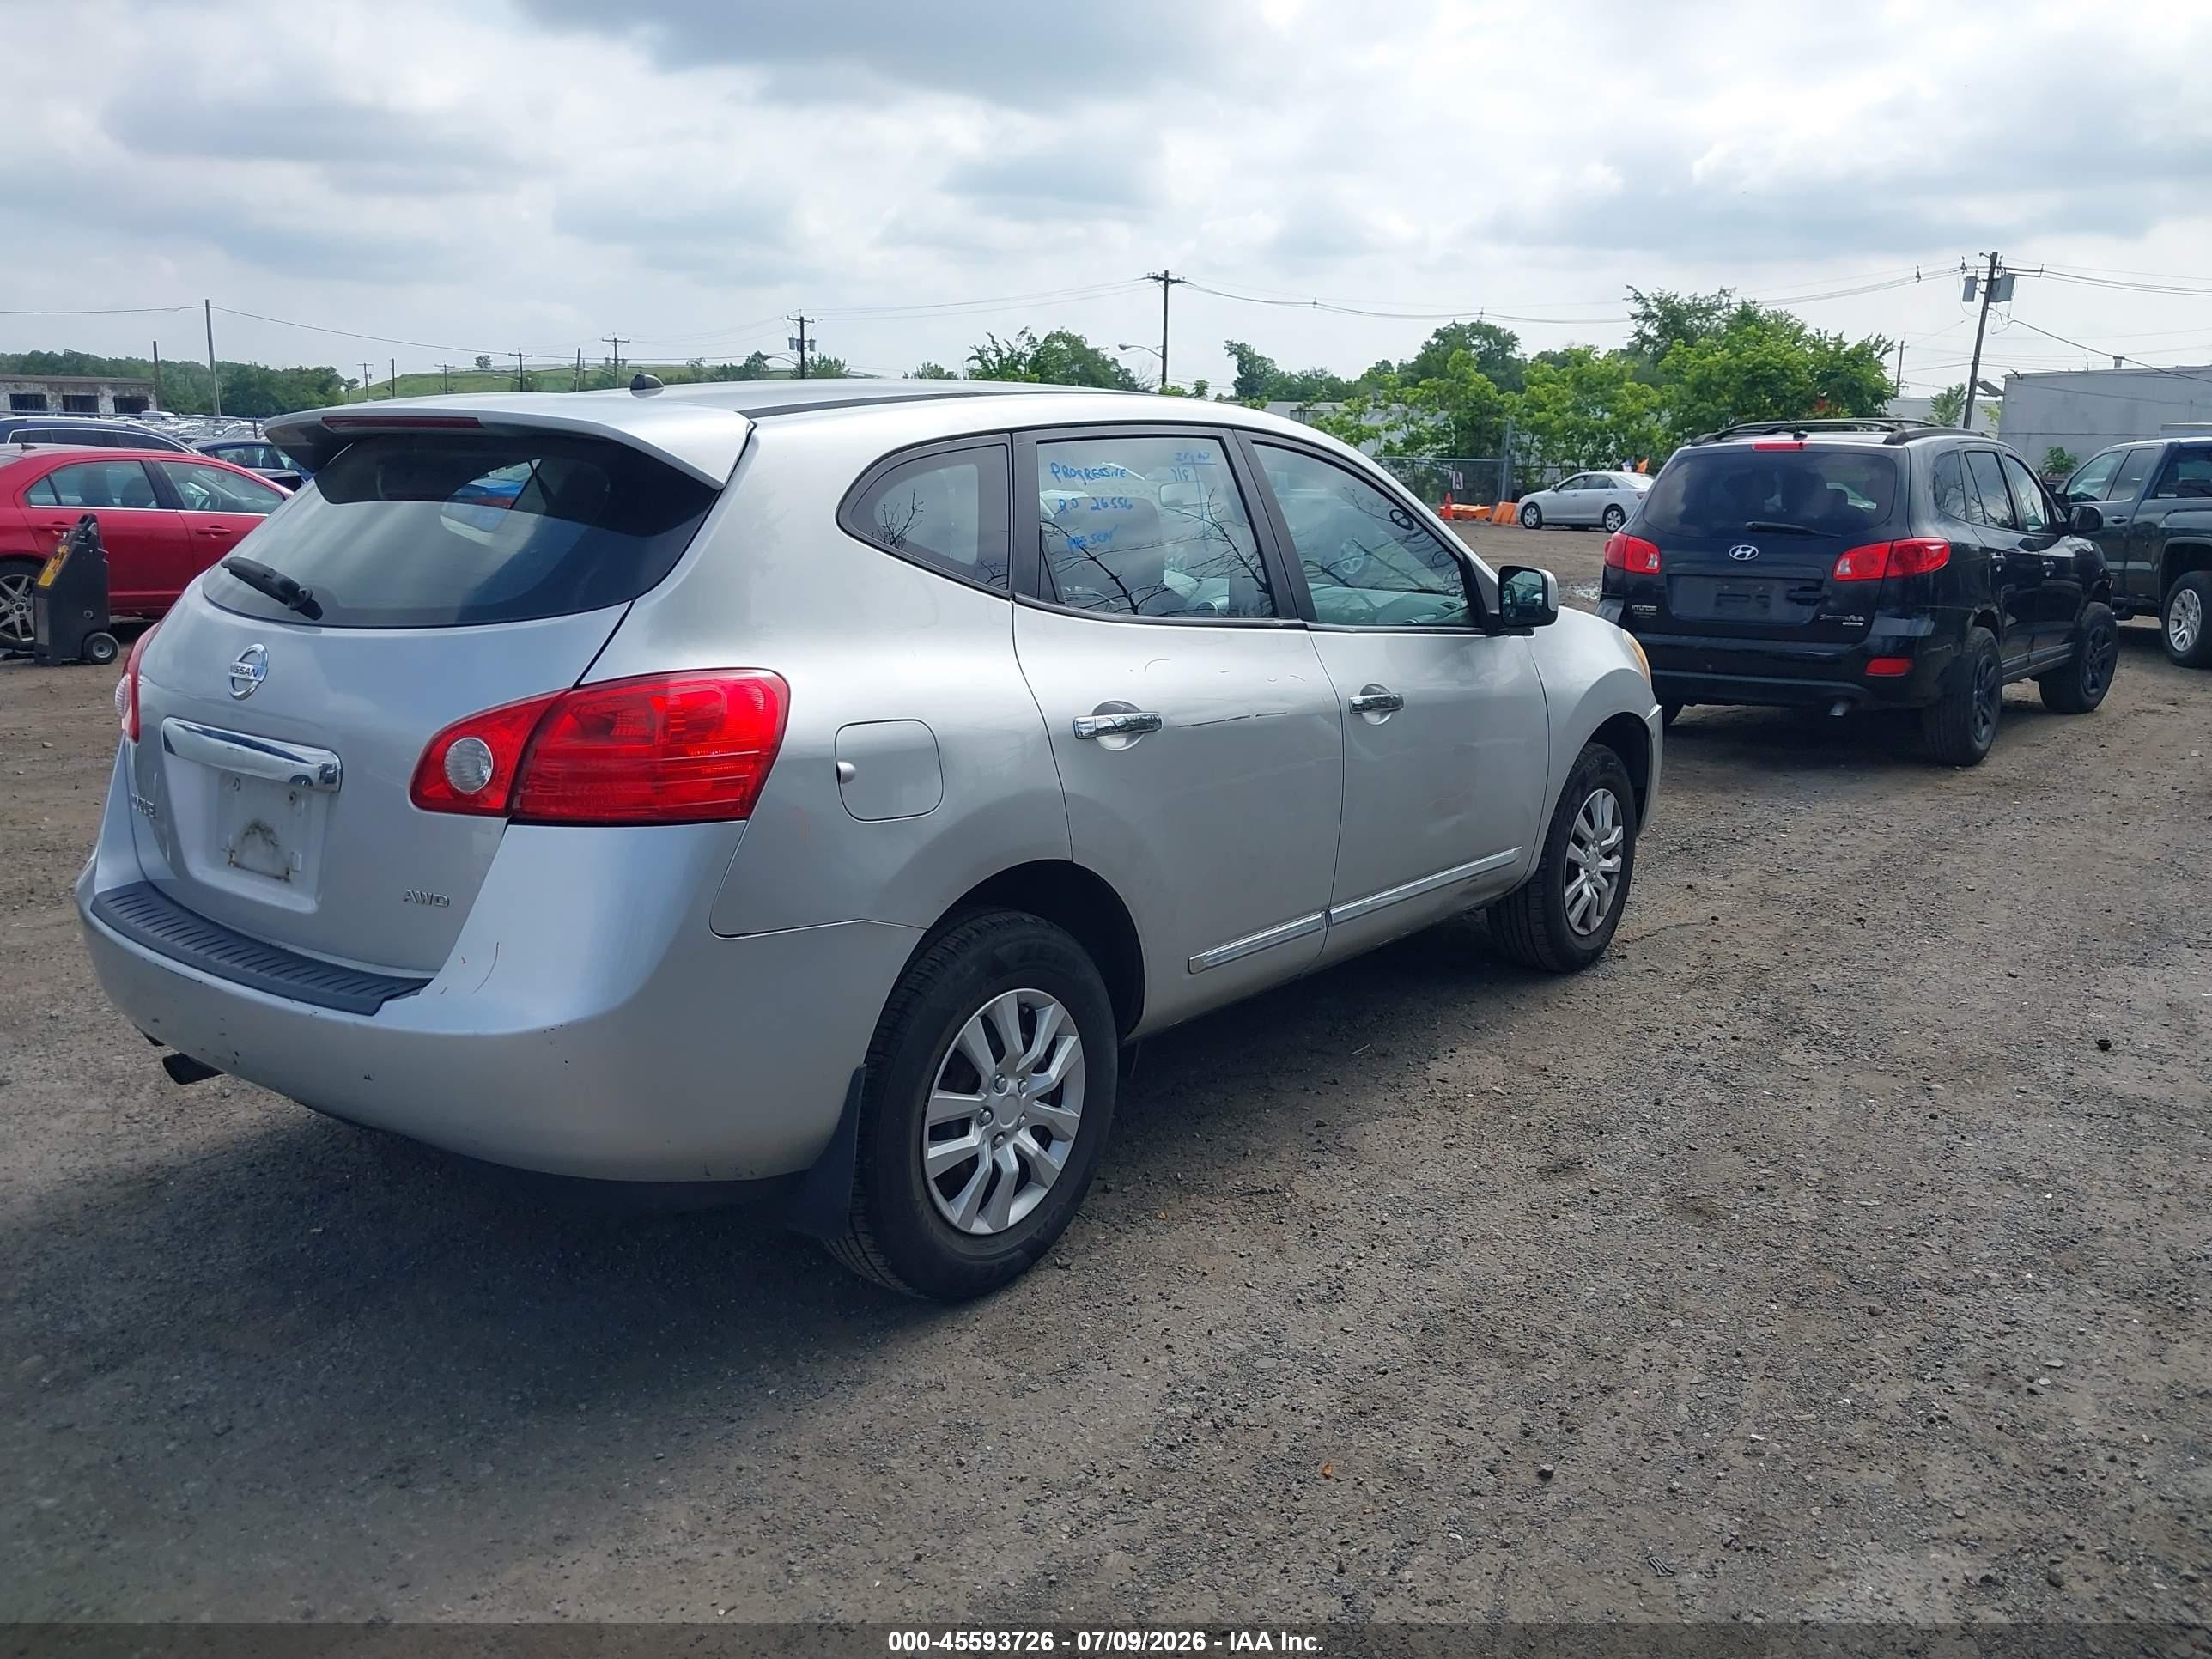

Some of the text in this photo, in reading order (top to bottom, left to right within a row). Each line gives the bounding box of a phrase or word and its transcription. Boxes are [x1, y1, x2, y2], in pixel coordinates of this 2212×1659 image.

[1455, 471, 1462, 489] A
[230, 665, 259, 678] NISSAN
[404, 889, 450, 908] AWD
